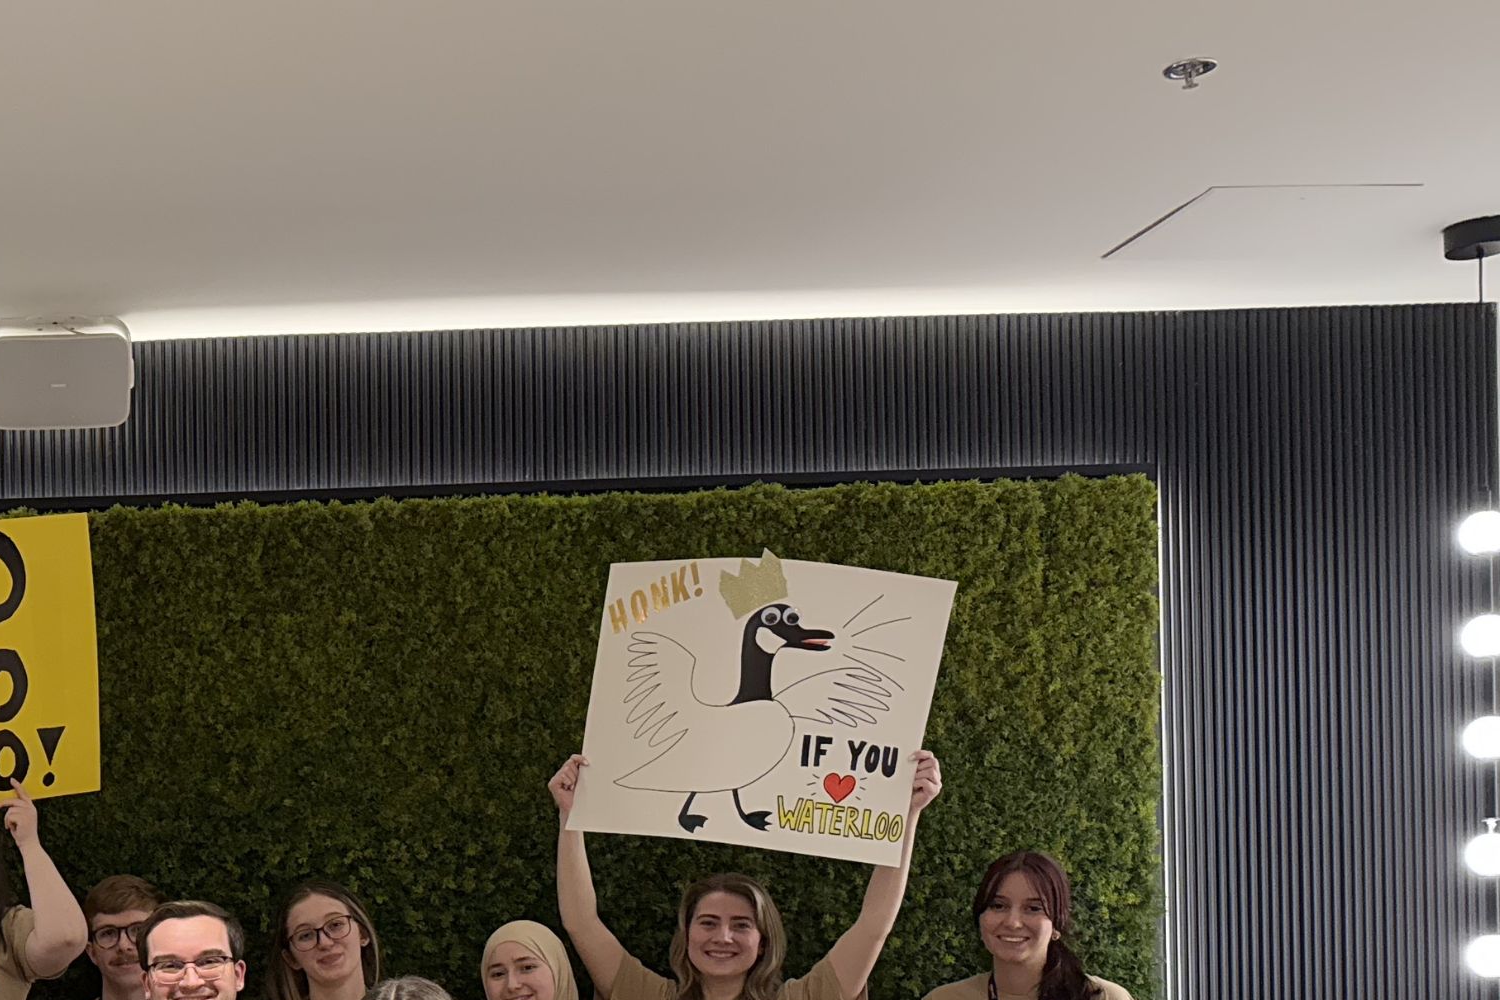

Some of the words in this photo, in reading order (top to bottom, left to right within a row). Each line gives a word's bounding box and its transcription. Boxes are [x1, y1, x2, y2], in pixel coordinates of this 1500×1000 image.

[608, 562, 703, 634] HONK!
[801, 735, 833, 767] IF
[847, 740, 899, 777] YOU
[777, 796, 903, 842] WATERLOO
